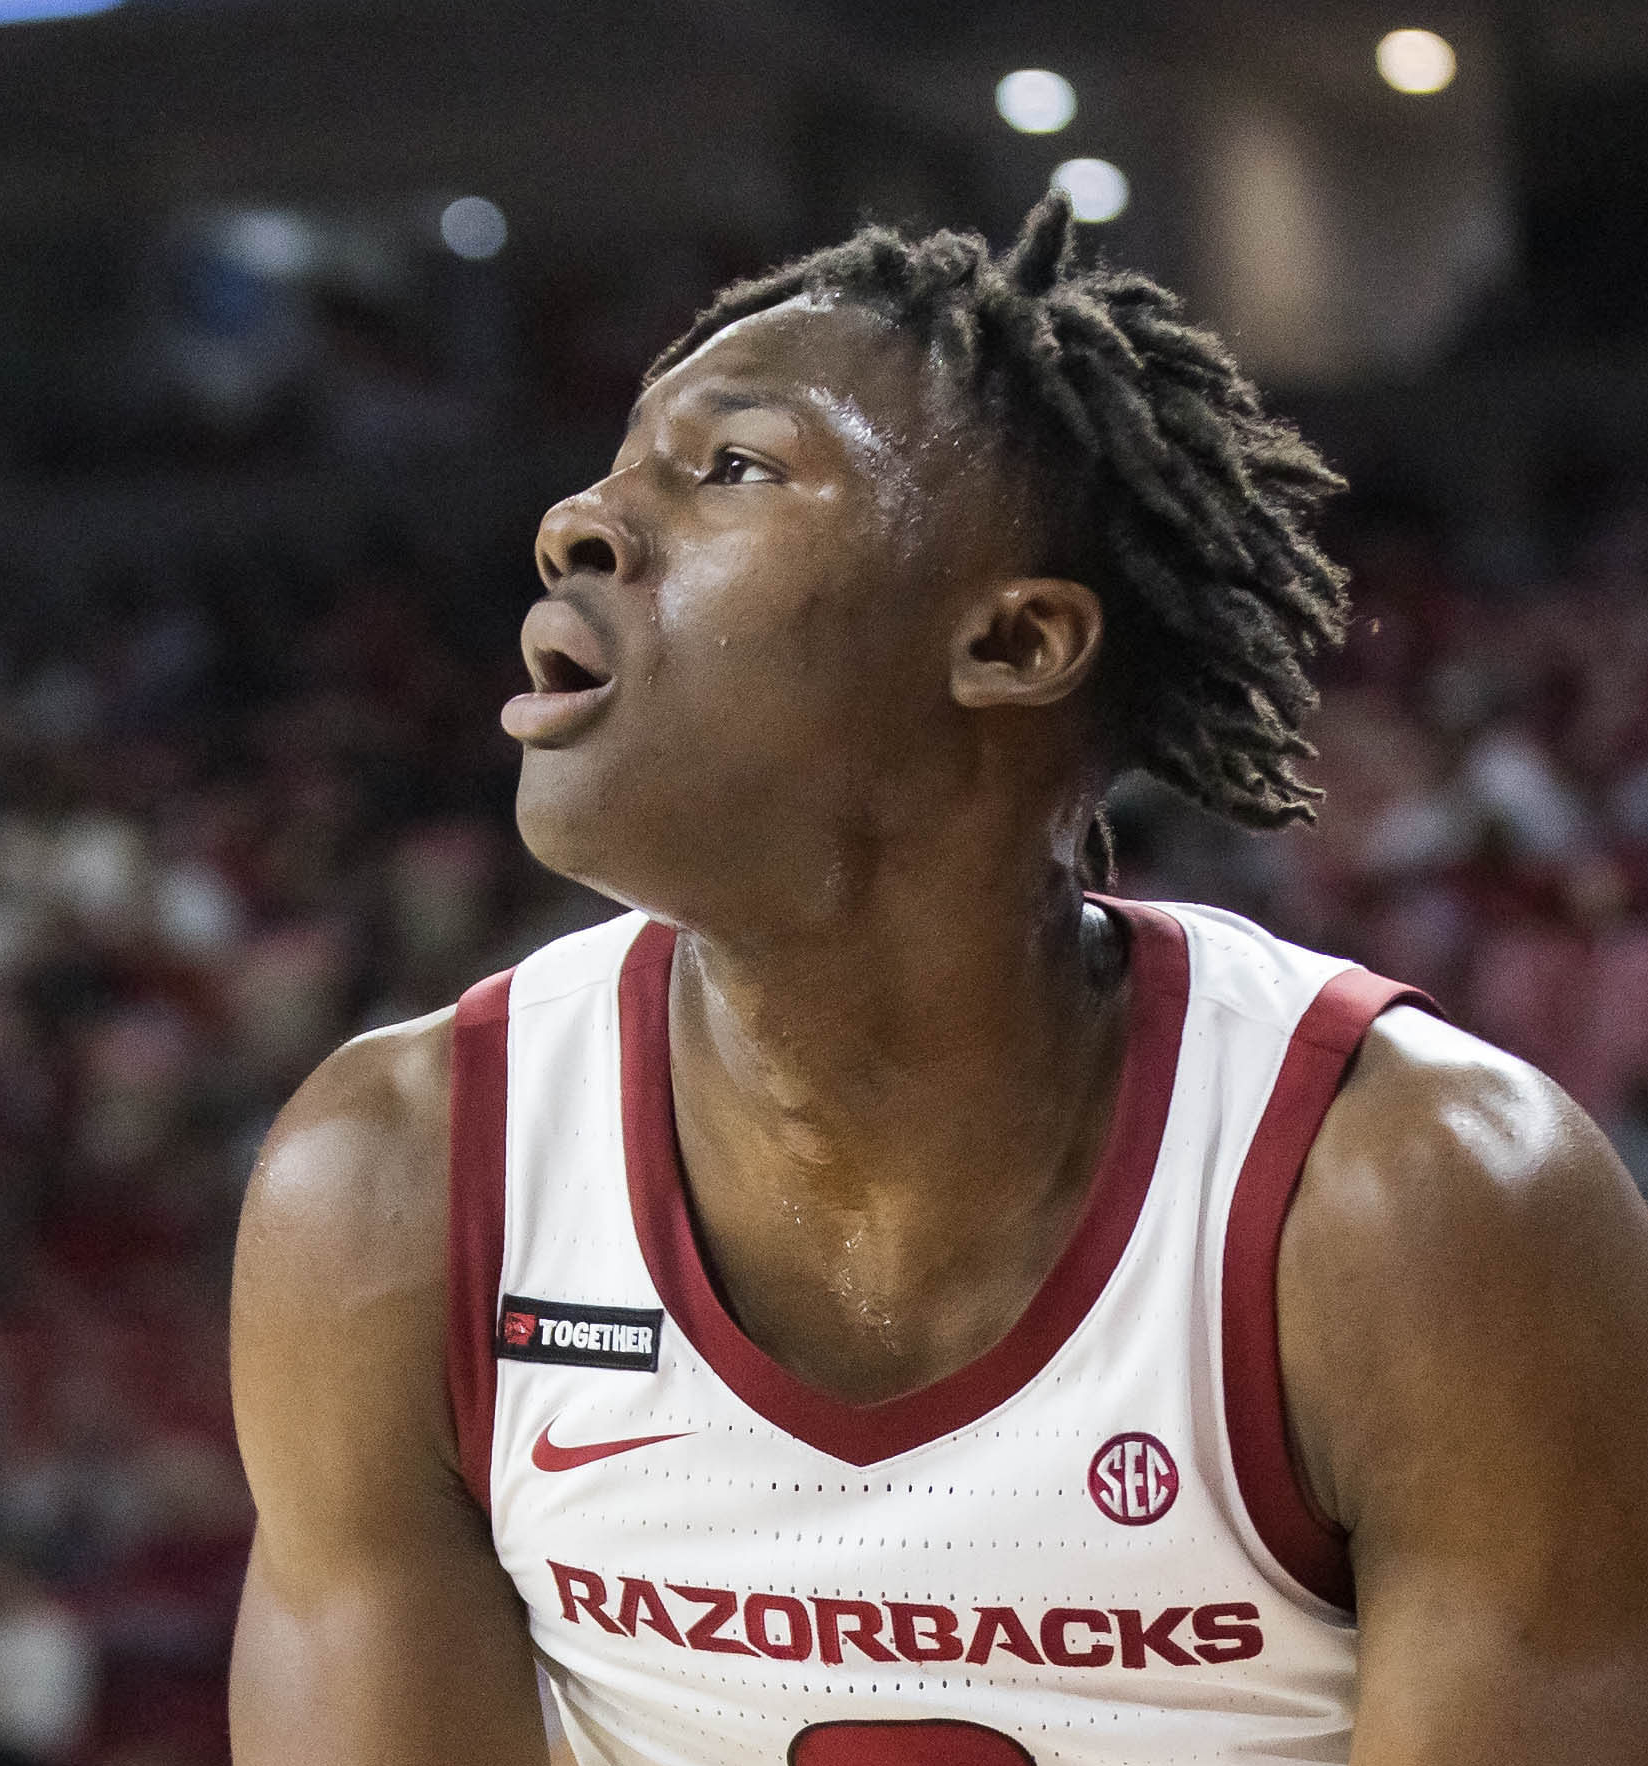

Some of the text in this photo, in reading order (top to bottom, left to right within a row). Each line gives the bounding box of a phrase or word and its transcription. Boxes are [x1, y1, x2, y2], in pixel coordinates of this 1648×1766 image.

[538, 1318, 653, 1354] TOGETHER
[1096, 1440, 1170, 1518] SEC
[546, 1558, 1264, 1669] RAZORBACKS
